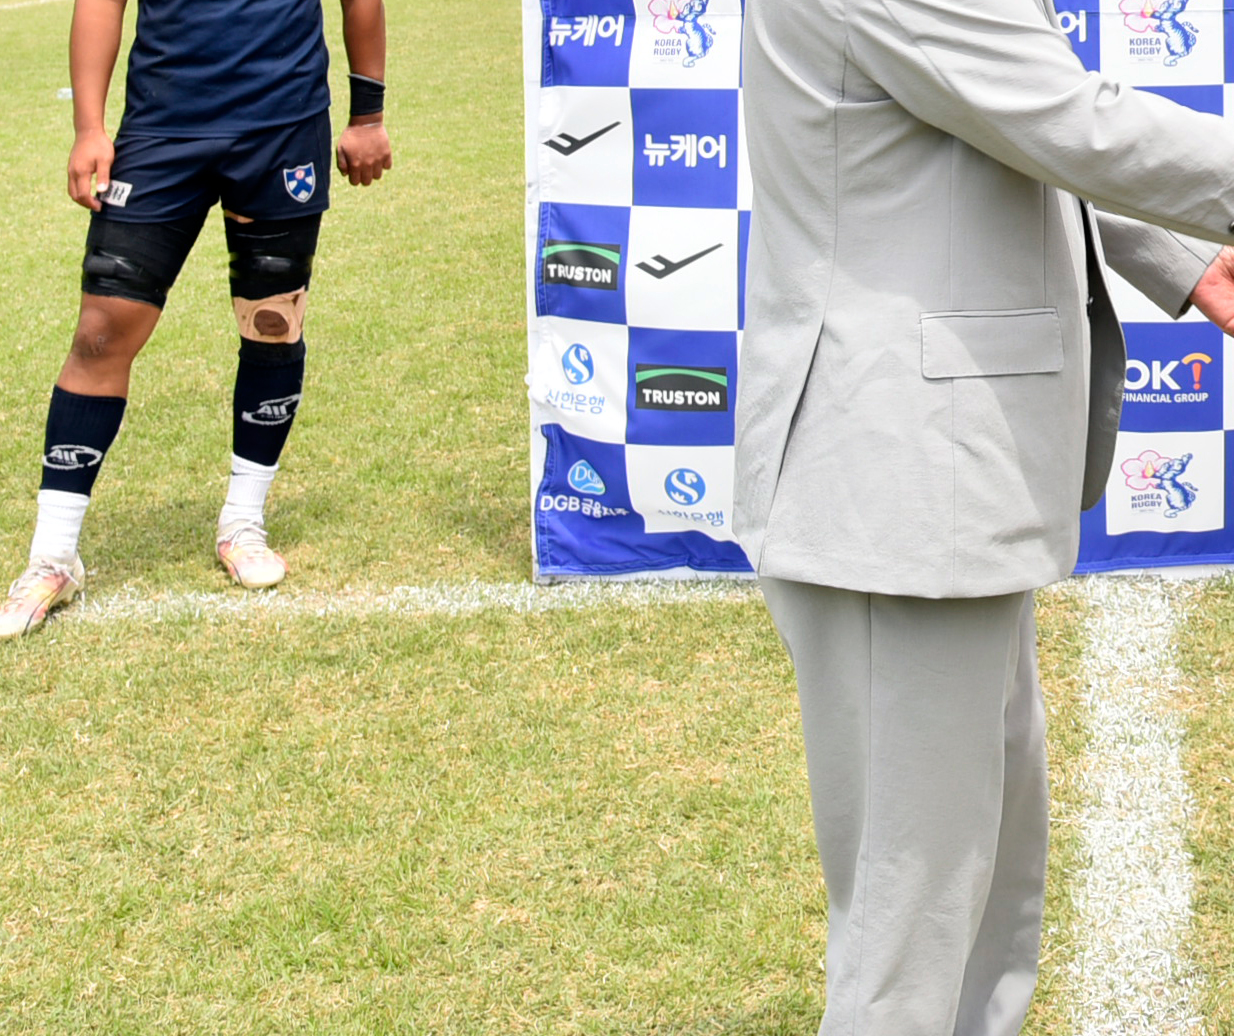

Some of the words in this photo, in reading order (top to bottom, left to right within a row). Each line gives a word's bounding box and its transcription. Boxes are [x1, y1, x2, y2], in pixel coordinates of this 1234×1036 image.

[549, 14, 625, 47] 뉴케어
[654, 38, 682, 47] KOREA
[1129, 37, 1161, 46] KOREA
[653, 47, 681, 56] RUGBY
[1129, 47, 1161, 56] RUGBY
[643, 133, 727, 168] 뉴케어
[547, 262, 612, 284] TRUSTON
[642, 388, 721, 406] TRUSTON
[1174, 392, 1209, 403] GROUP
[1131, 492, 1162, 502] KOREA
[1131, 500, 1162, 510] RUGBY
